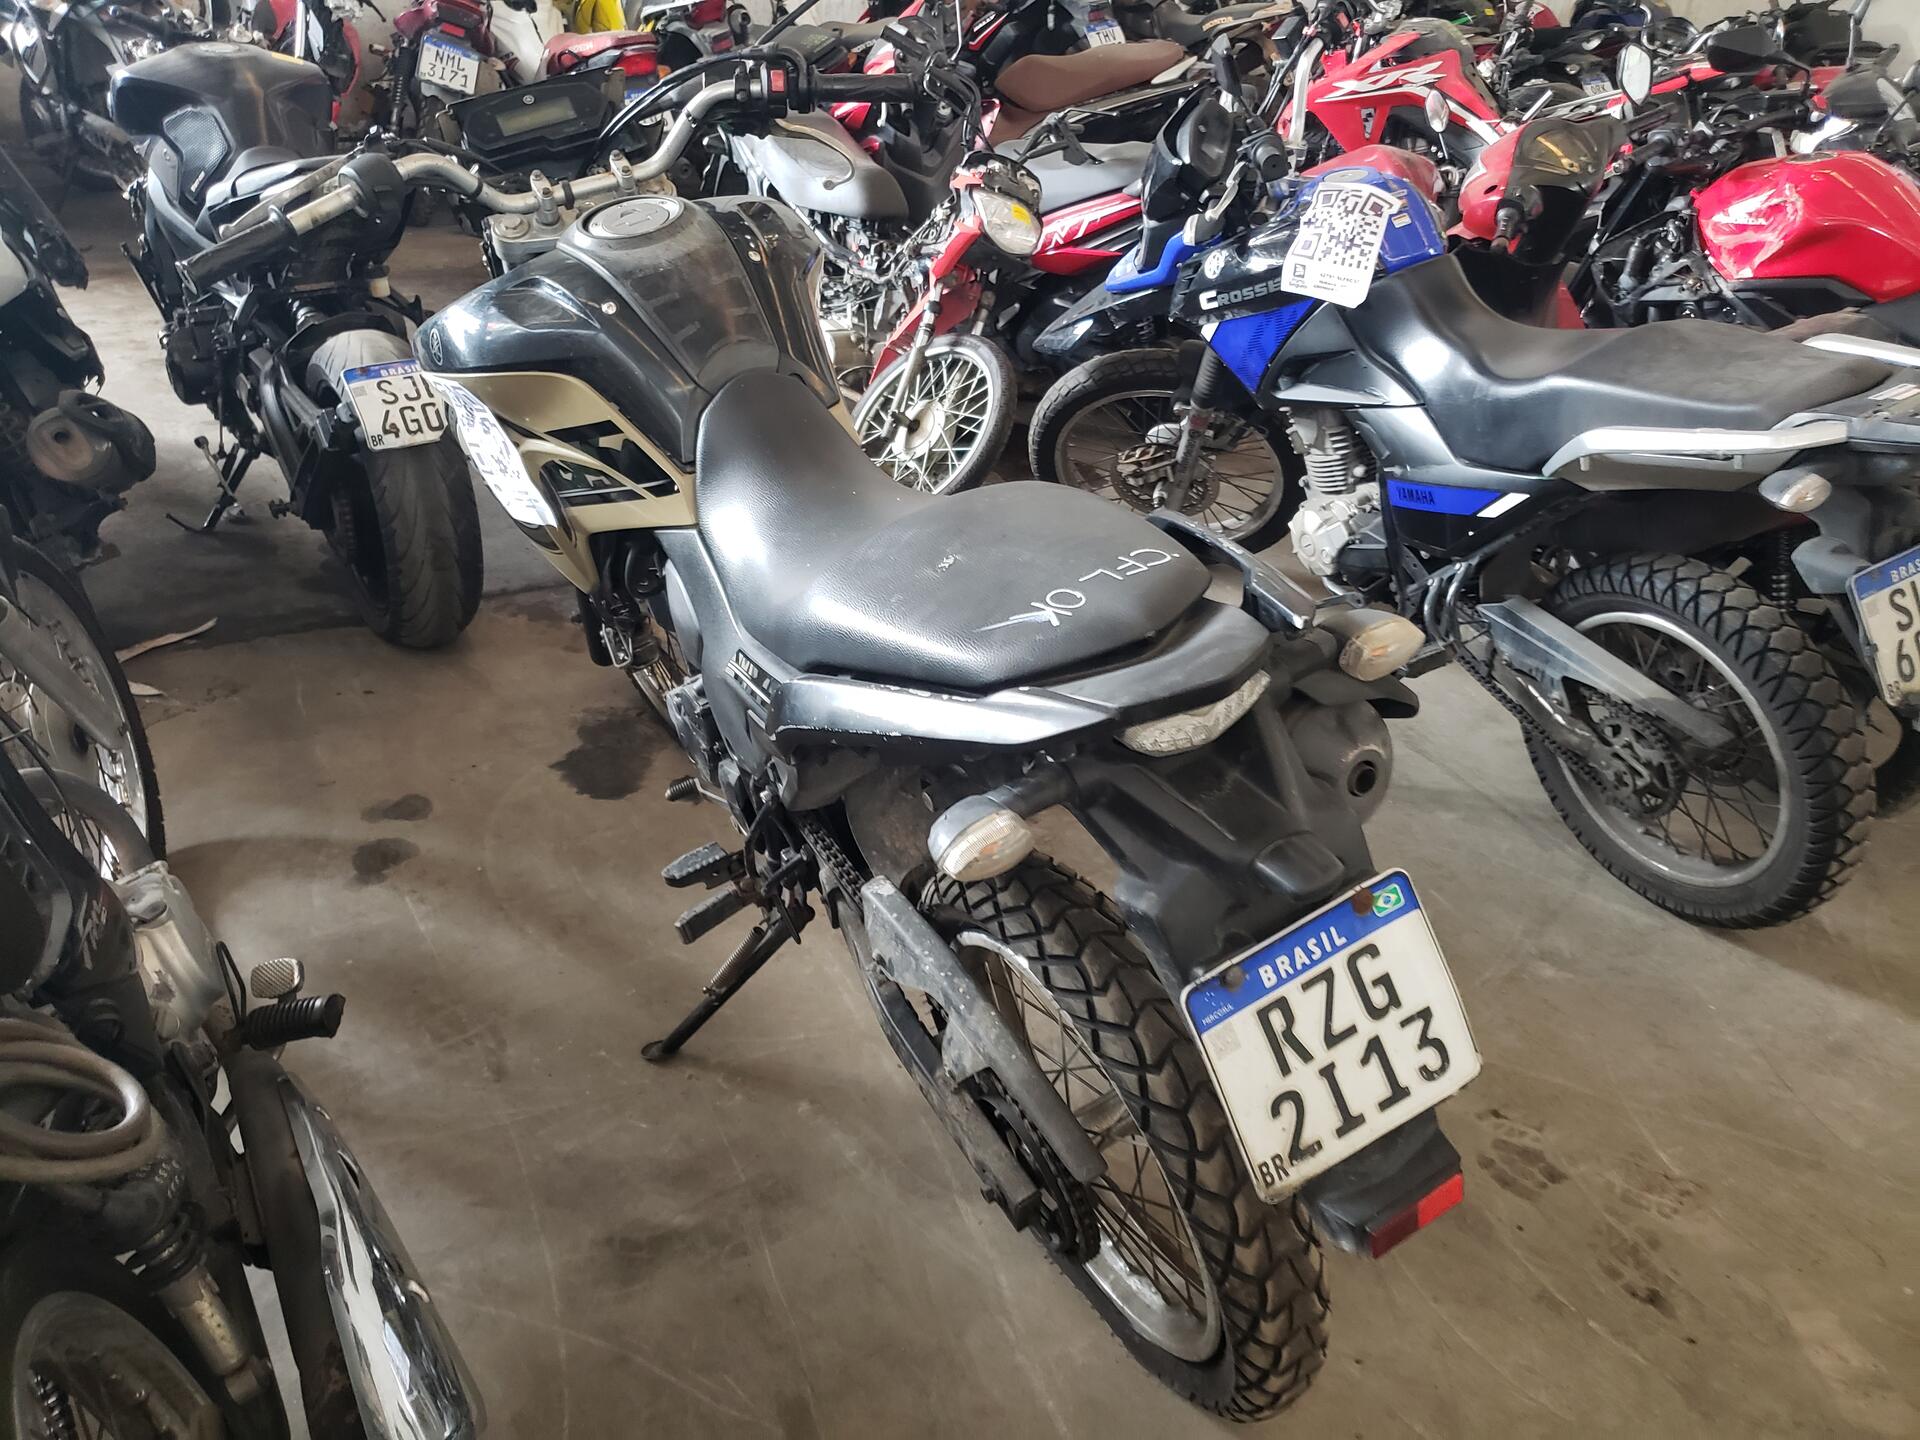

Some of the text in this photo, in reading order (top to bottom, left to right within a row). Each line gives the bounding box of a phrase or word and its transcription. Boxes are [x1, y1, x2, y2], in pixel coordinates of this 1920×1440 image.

[435, 48, 466, 73] NML
[370, 432, 386, 448] BR
[1397, 486, 1436, 506] YAMAHA
[1889, 580, 1920, 633] S
[1896, 630, 1920, 684] 6
[1257, 925, 1349, 990] BRASIL
[1256, 943, 1402, 1078] RZG
[1270, 1006, 1451, 1163] 2I13
[1256, 1152, 1291, 1189] BR
